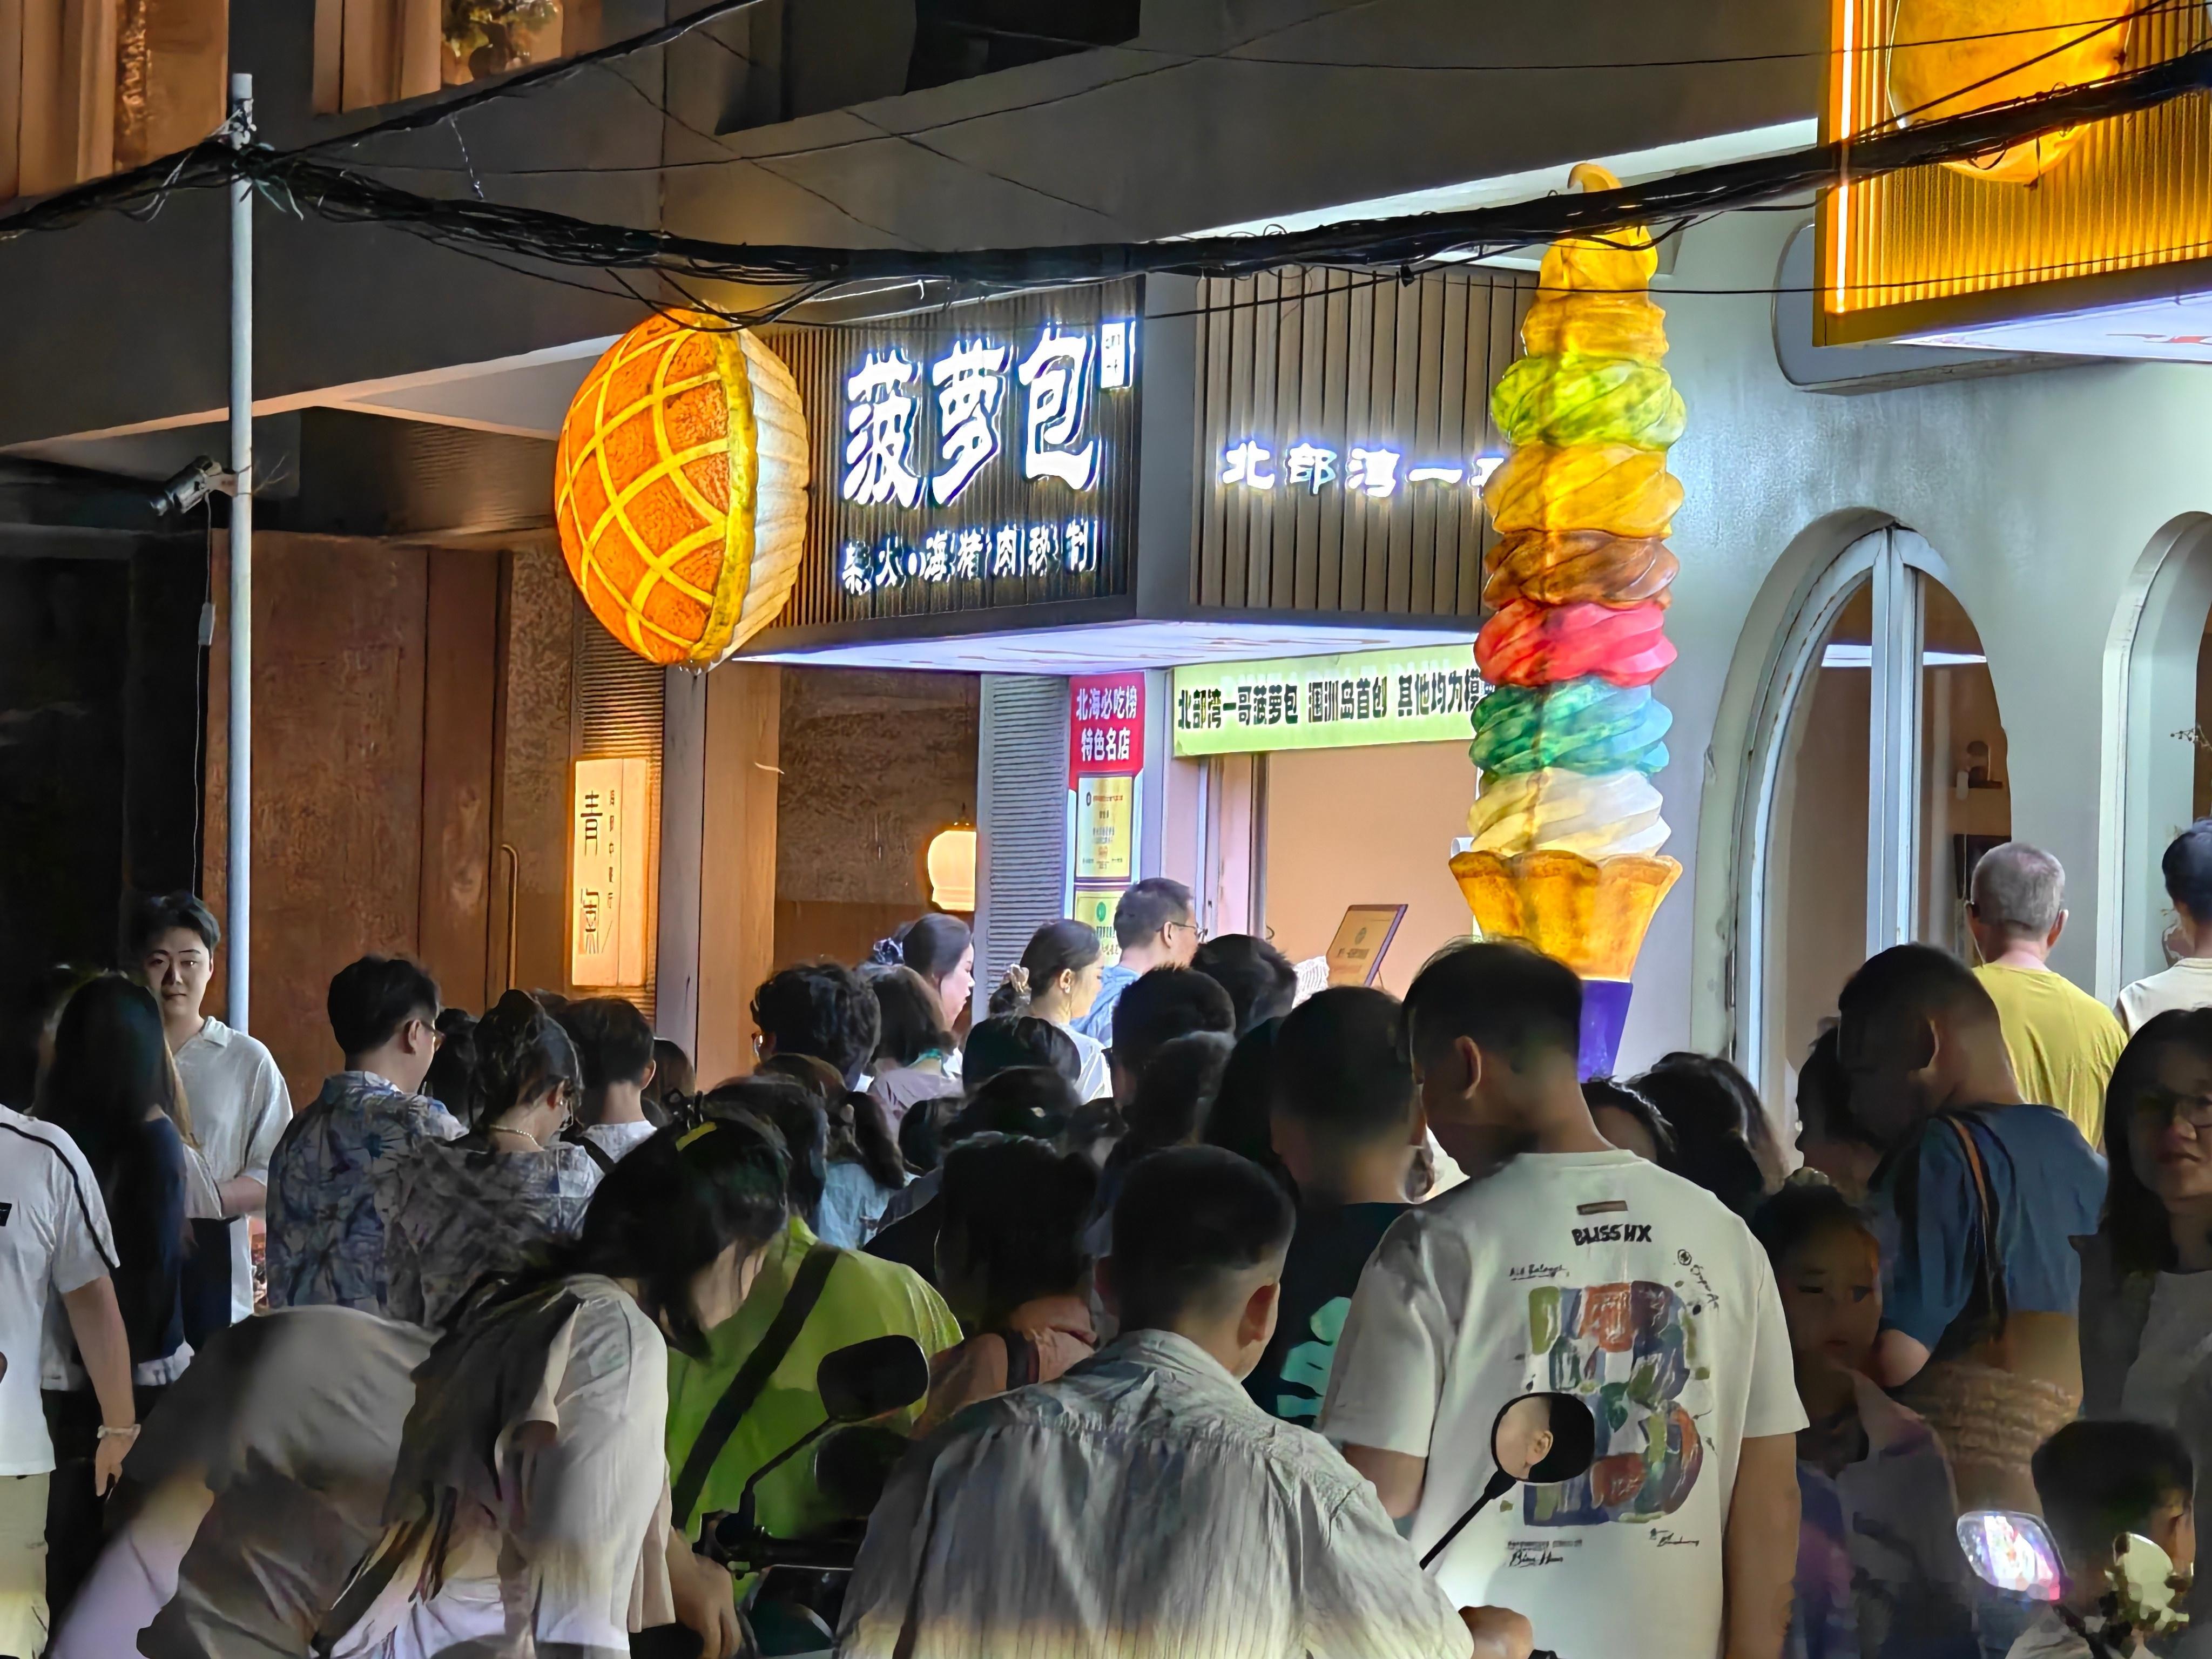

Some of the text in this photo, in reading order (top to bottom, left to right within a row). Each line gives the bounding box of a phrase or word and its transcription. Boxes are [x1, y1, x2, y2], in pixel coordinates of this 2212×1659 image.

[843, 323, 1098, 508] 菠萝包
[1076, 685, 1137, 721] 北海必吃榜
[1178, 669, 1495, 730] 北部湾一哥菠萝包 涠洲岛首创 其他均为模
[1081, 726, 1131, 761] 特色名店
